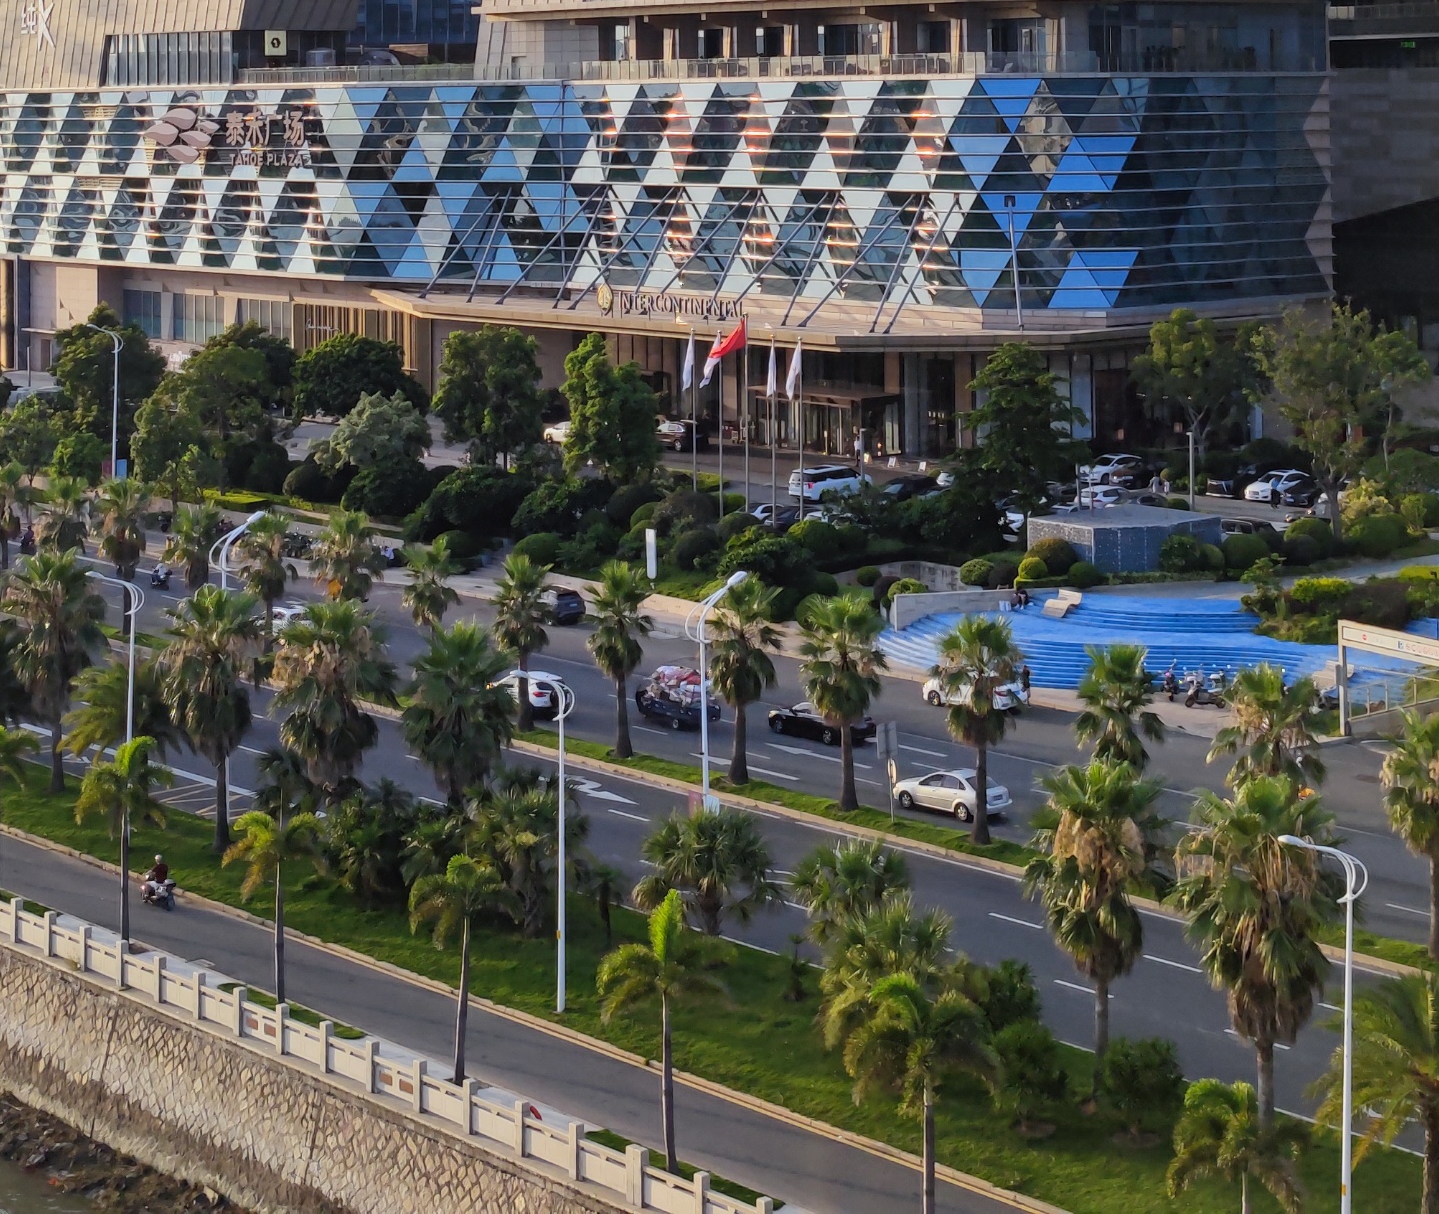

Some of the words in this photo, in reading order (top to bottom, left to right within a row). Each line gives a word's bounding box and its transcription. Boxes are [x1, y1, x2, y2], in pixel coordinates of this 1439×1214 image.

[225, 108, 304, 146] 泰禾广场
[229, 153, 263, 166] TAHOE
[267, 154, 304, 167] PLAZA
